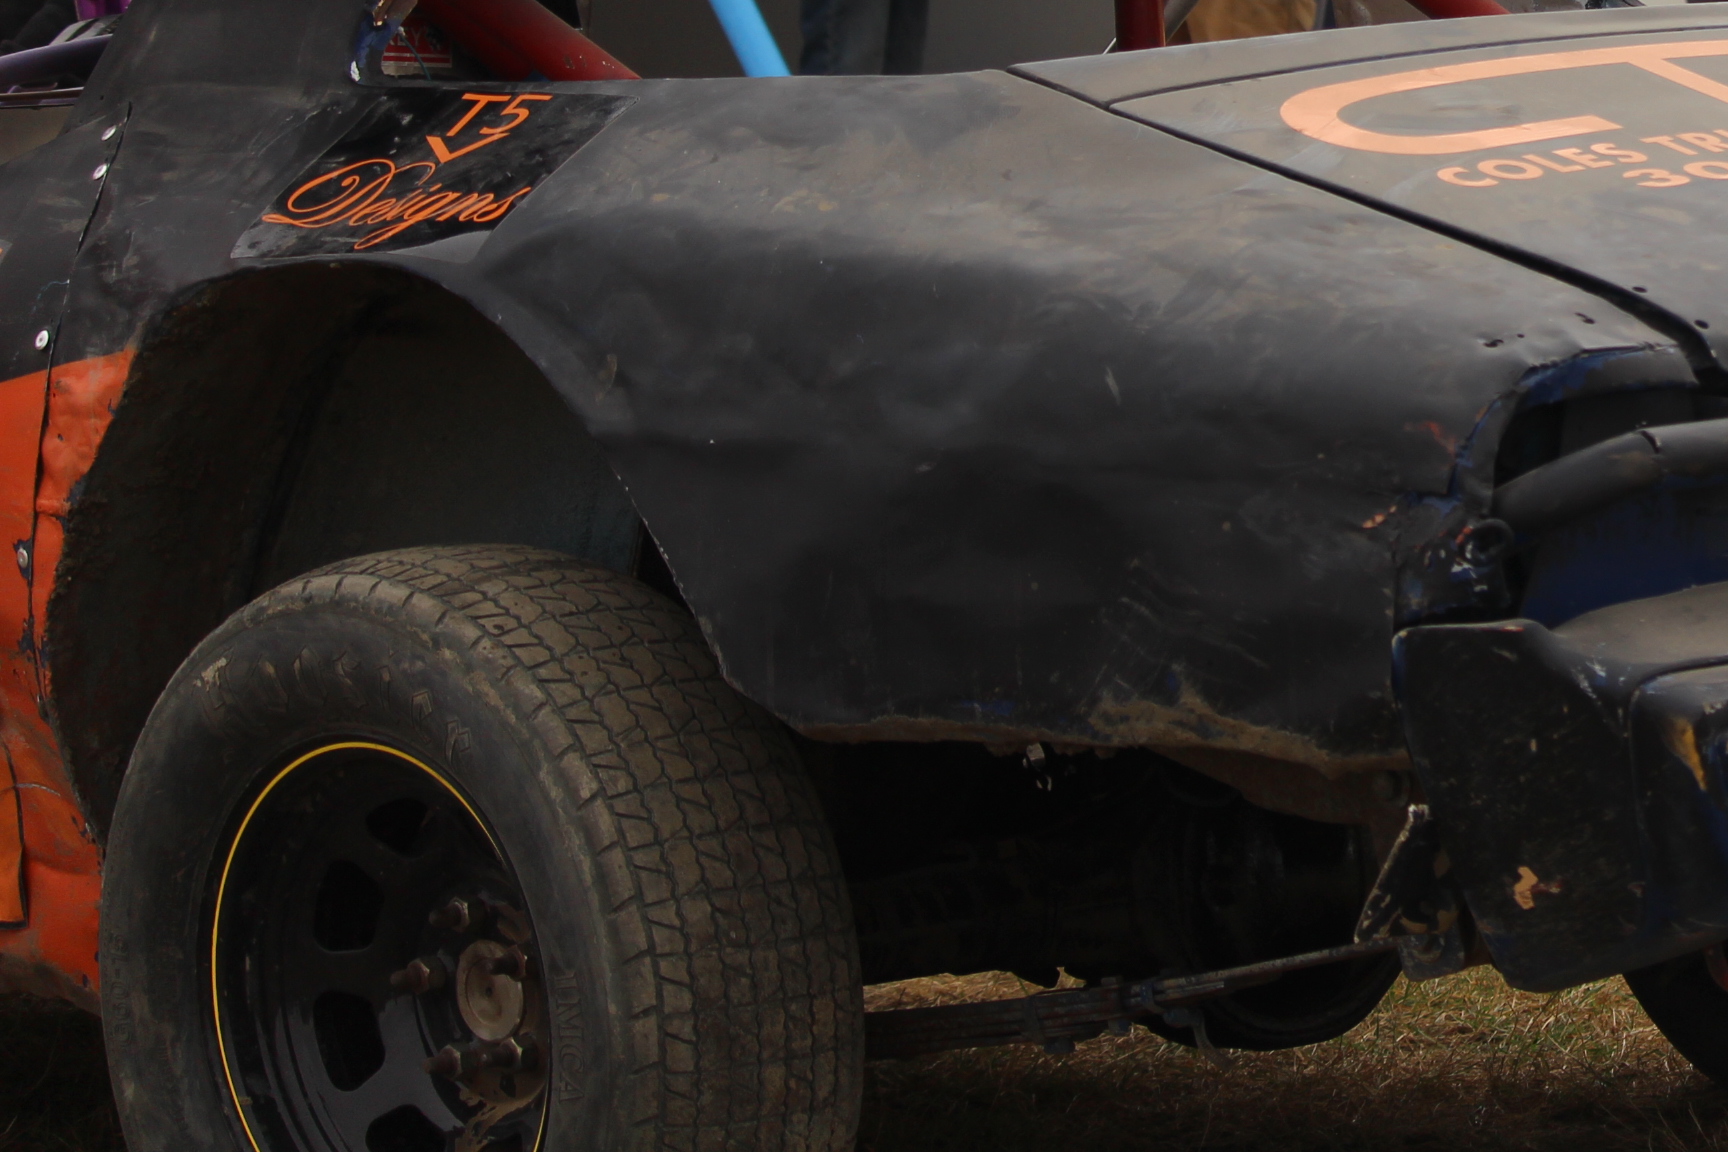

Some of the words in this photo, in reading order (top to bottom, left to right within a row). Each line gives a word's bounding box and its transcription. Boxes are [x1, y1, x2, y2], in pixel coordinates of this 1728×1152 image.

[261, 158, 532, 250] Designs
[1437, 142, 1649, 188] COLES
[553, 969, 587, 1105] IMCA
